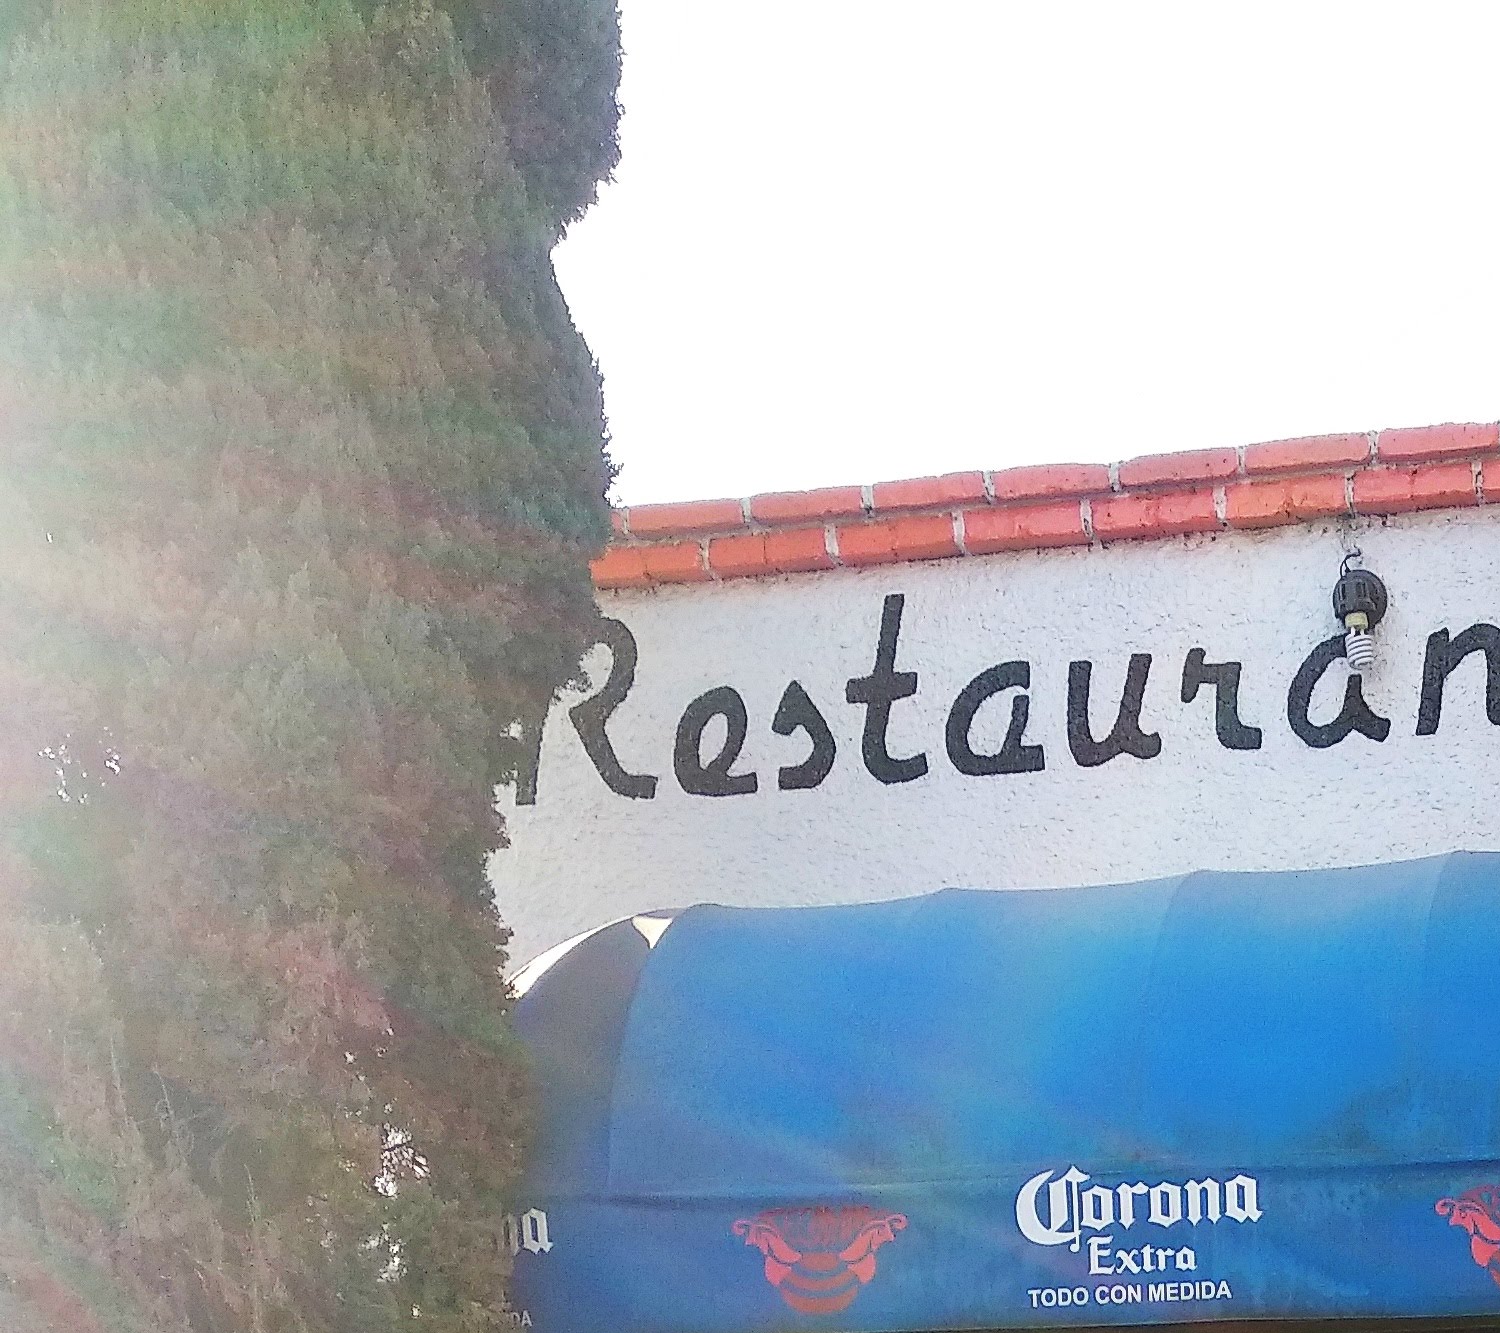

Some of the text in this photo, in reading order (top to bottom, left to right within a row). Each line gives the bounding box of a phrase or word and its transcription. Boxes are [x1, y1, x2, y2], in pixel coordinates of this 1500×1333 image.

[1016, 1165, 1263, 1253] Corona
[1086, 1235, 1198, 1275] Extra
[1028, 1281, 1232, 1308] TODO CON MEDIDA
